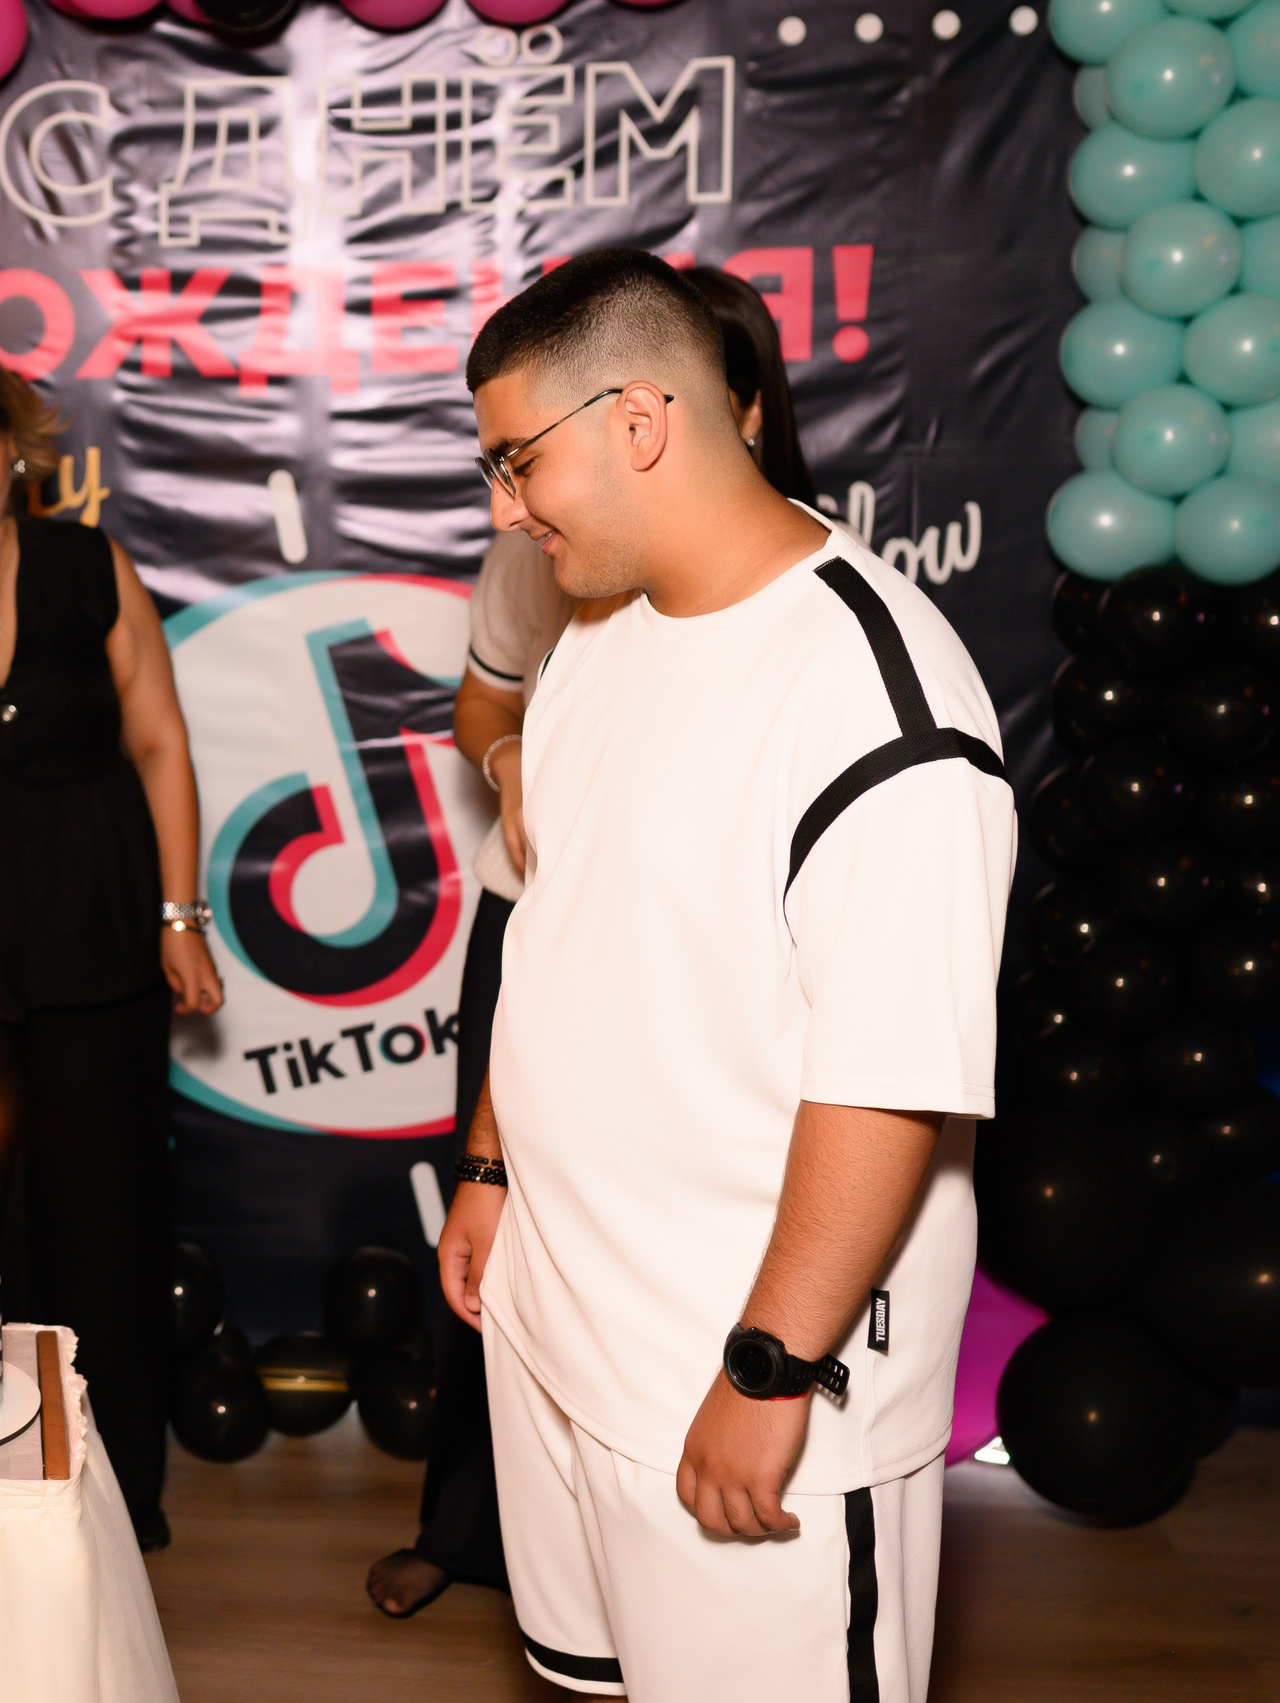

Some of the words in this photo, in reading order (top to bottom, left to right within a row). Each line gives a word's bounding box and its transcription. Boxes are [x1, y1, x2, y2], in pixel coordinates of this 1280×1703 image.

[158, 23, 735, 246] ДНЁМ
[243, 1008, 459, 1095] TikTok
[875, 1297, 887, 1342] TUESDAY
